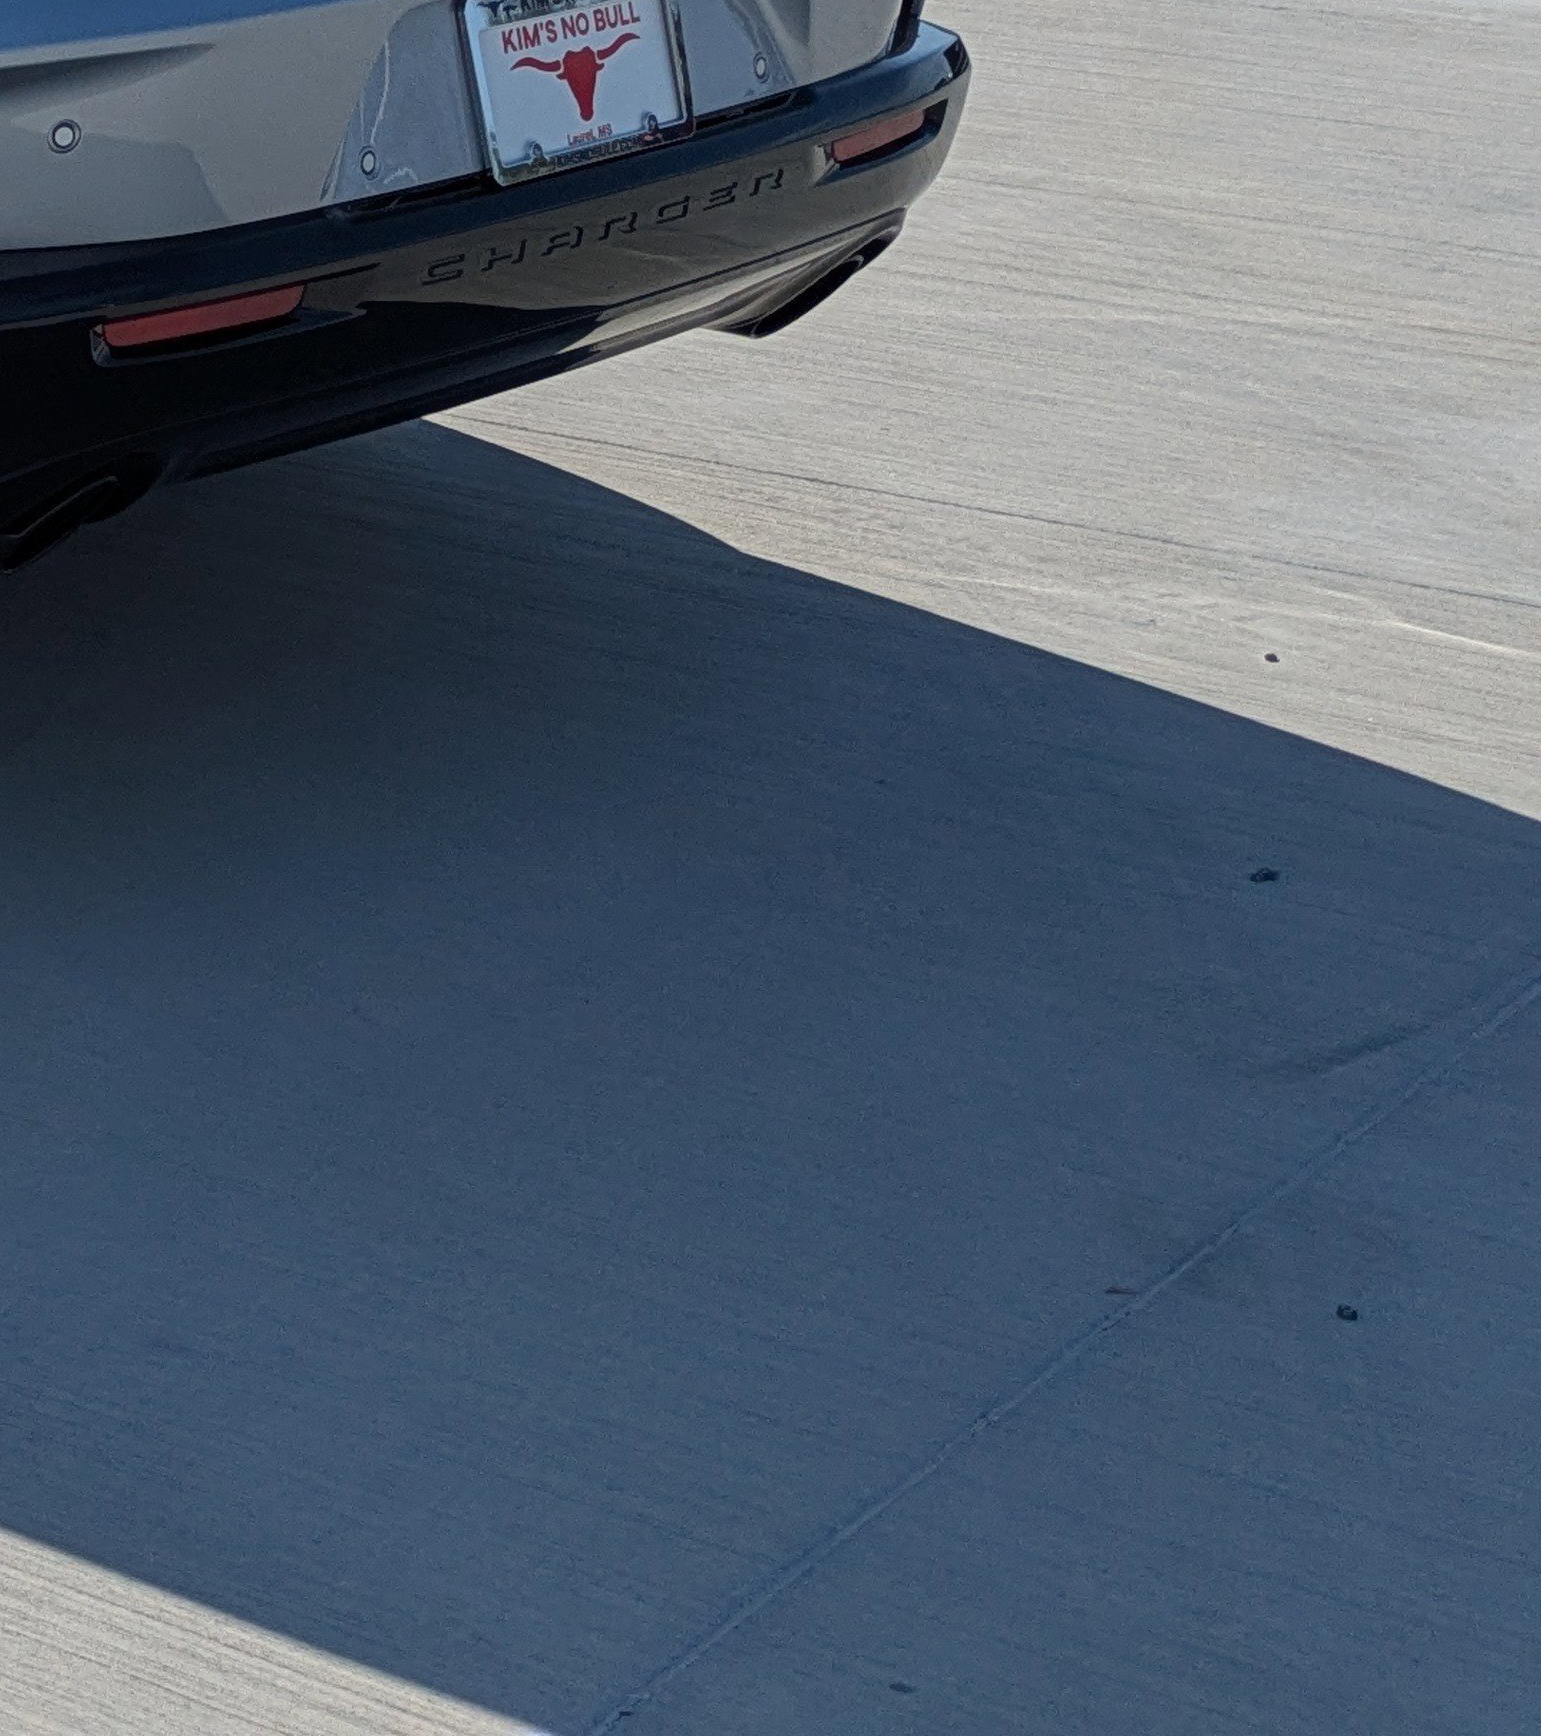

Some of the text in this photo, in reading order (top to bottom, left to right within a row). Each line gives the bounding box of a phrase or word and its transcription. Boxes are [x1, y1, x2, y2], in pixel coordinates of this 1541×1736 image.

[501, 1, 641, 54] KIM'S NO BULL
[421, 168, 784, 286] CHARGER
